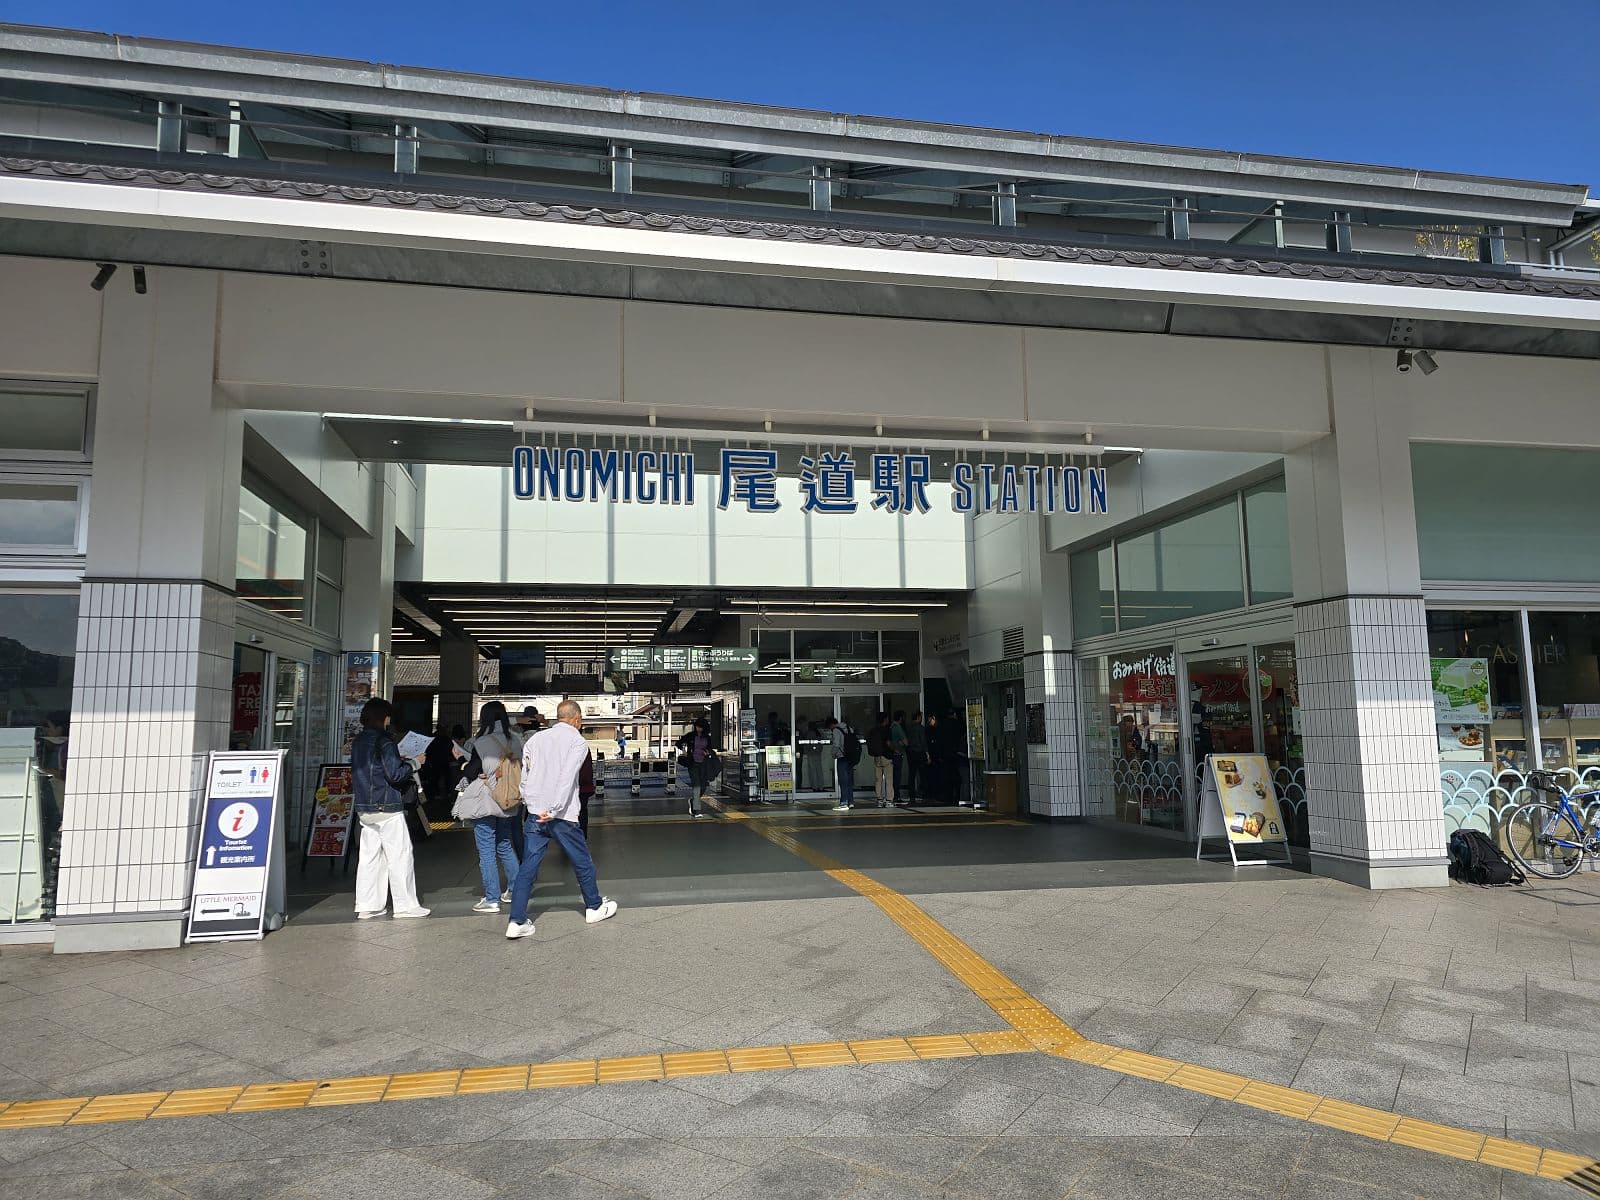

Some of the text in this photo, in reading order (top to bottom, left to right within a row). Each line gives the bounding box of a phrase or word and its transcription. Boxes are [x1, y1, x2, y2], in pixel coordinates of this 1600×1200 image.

[513, 446, 1109, 515] ONOMICHI 尾道駅 STATION
[1475, 642, 1568, 664] CASIER
[238, 697, 262, 709] FRE
[222, 895, 257, 903] MERMAID
